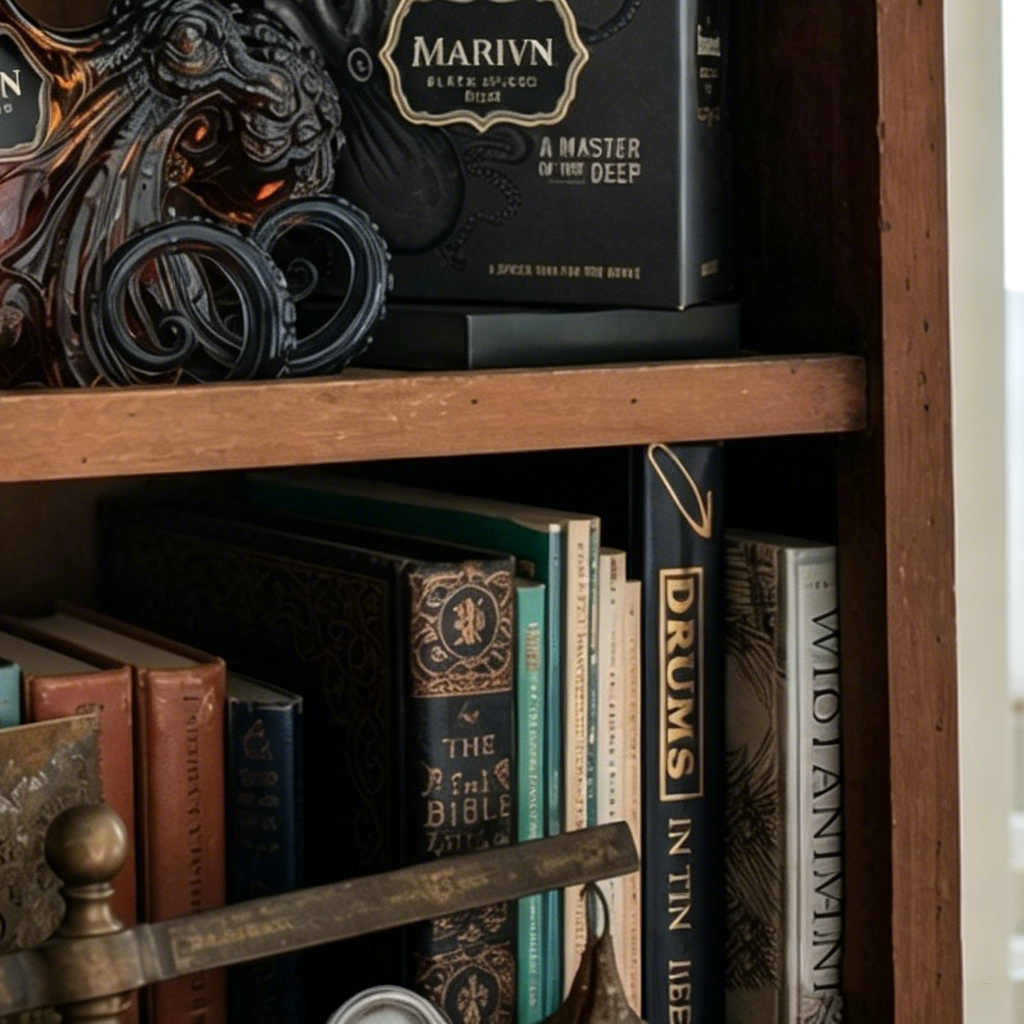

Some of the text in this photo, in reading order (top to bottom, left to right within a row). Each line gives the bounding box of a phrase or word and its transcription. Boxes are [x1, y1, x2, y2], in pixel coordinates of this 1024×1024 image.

[412, 35, 553, 67] MARIVN
[559, 137, 640, 159] MASTER
[590, 162, 641, 184] DEEP
[666, 577, 695, 779] DRUMS
[442, 733, 495, 759] THE
[425, 793, 510, 828] BIBLE
[668, 818, 692, 855] IN
[668, 864, 692, 930] TIN
